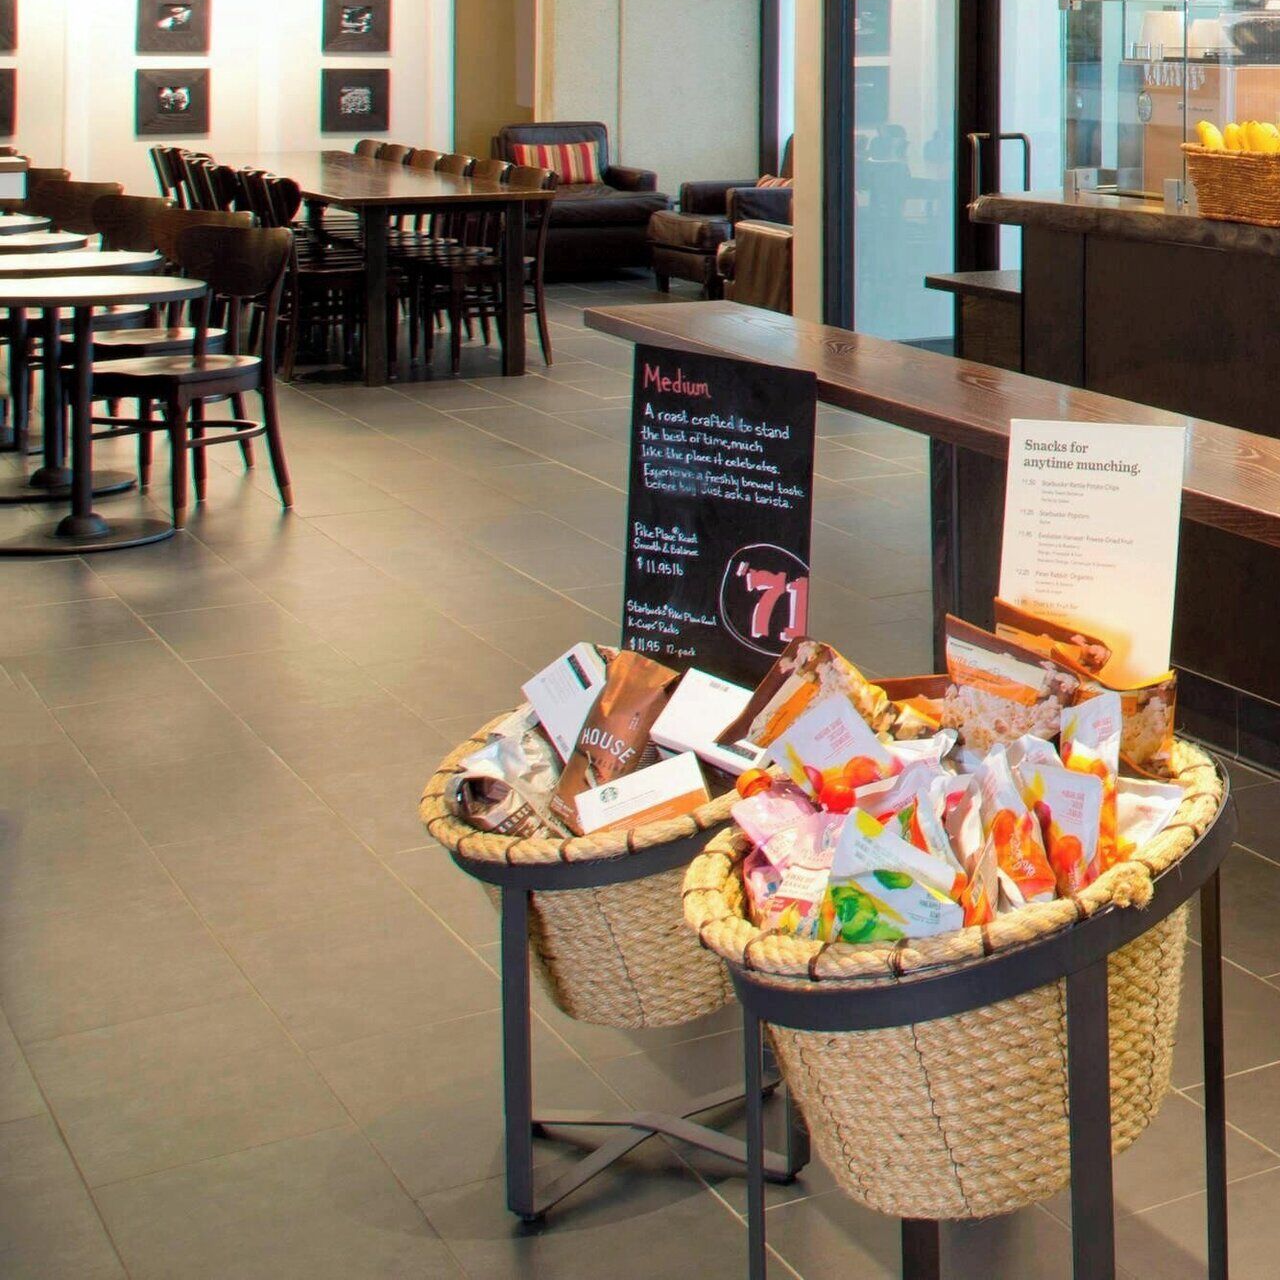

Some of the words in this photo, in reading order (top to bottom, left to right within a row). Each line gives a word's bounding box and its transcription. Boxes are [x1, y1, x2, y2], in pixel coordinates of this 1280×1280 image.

[643, 362, 712, 399] Medium
[645, 402, 655, 420] A
[658, 409, 689, 424] roast
[691, 413, 735, 430] crafted
[738, 418, 753, 433] to
[755, 422, 791, 440] stand
[641, 425, 661, 441] the
[662, 428, 688, 442] best
[689, 431, 701, 445] of
[731, 440, 763, 453] much
[1024, 439, 1068, 453] Snacks
[1070, 441, 1089, 453] for
[641, 444, 663, 458] like
[666, 447, 684, 461] the
[686, 450, 712, 464] place
[714, 452, 724, 465] it
[725, 457, 780, 474] celebrates.
[1023, 456, 1074, 470] anytime
[1076, 460, 1141, 477] munching.
[645, 478, 677, 491] before
[701, 483, 723, 497] Just
[724, 487, 744, 500] ask
[745, 492, 751, 502] a
[755, 491, 793, 509] barista.
[704, 471, 740, 489] freshly
[741, 476, 774, 491] brewed
[777, 482, 804, 497] taste
[633, 538, 661, 551] Smooth
[635, 522, 655, 539] Pike
[678, 532, 698, 544] Roast
[658, 622, 680, 635] Packs
[581, 727, 636, 764] HOUSE
